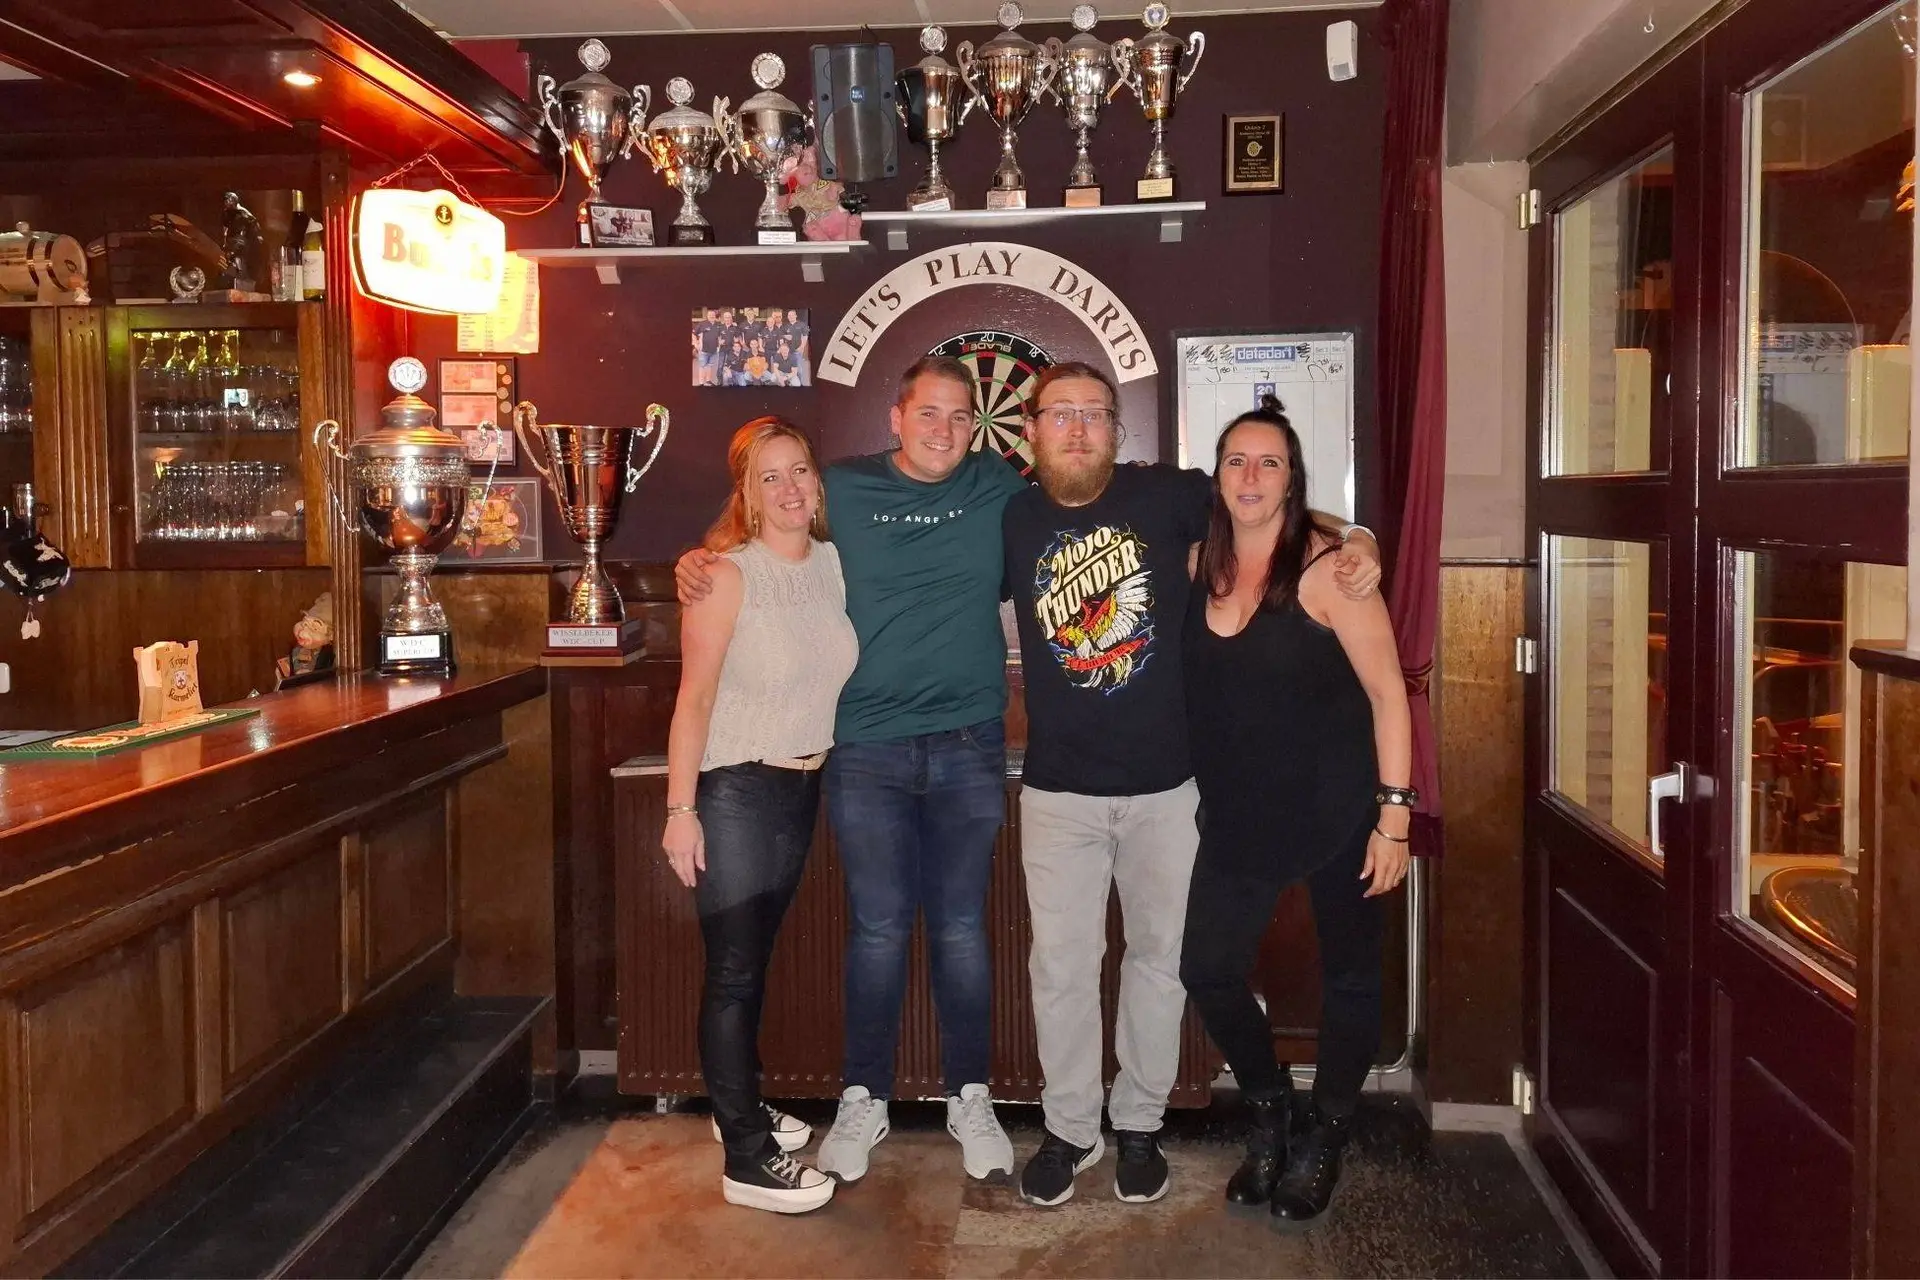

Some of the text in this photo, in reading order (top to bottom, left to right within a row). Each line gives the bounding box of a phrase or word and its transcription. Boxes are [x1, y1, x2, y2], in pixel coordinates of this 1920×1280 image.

[830, 250, 1148, 373] LET'S PLAY DARTS
[980, 332, 995, 342] 20
[1028, 346, 1039, 358] 18
[1257, 385, 1274, 396] 20
[905, 509, 963, 524] ANGEE
[1051, 526, 1113, 594] MOJO
[1036, 539, 1141, 640] THUNDER
